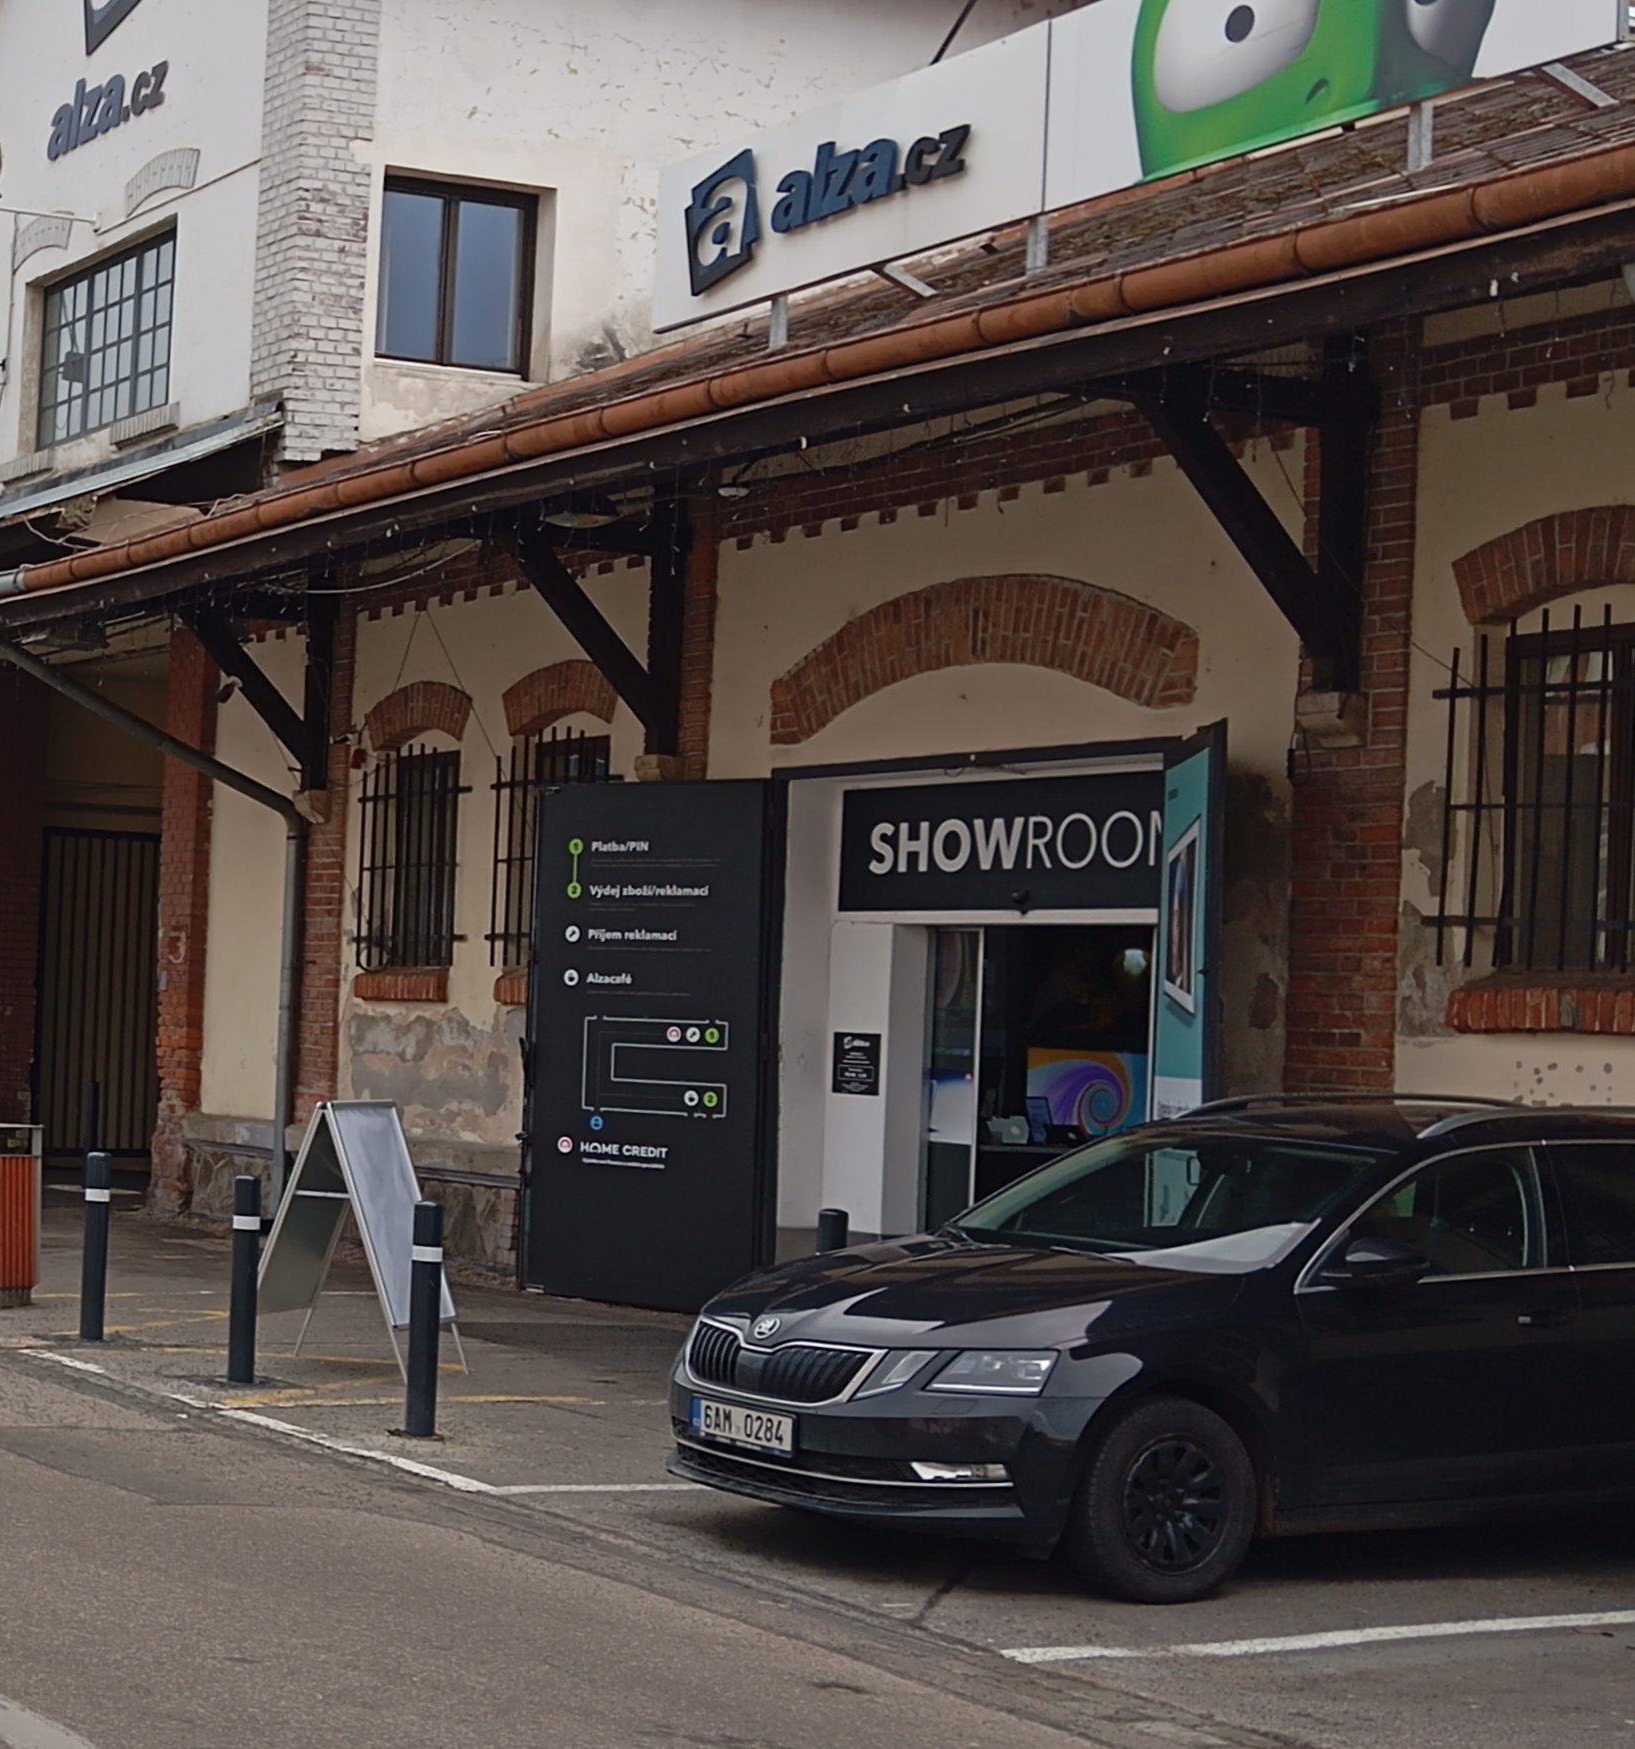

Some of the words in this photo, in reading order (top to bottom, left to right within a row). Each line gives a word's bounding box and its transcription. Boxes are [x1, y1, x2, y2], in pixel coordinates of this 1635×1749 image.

[47, 60, 169, 161] alza.cz
[771, 124, 971, 233] alza.cz
[591, 841, 649, 852] Platba/PIN
[589, 884, 620, 898] Výdej
[622, 885, 709, 896] zboží/reklamací
[624, 929, 677, 941] reklamací
[586, 973, 633, 985] Alzacafé
[580, 1142, 620, 1155] HOME
[622, 1144, 668, 1158] CREDIT
[704, 1405, 733, 1434] 6AM
[744, 1413, 784, 1446] 0284
